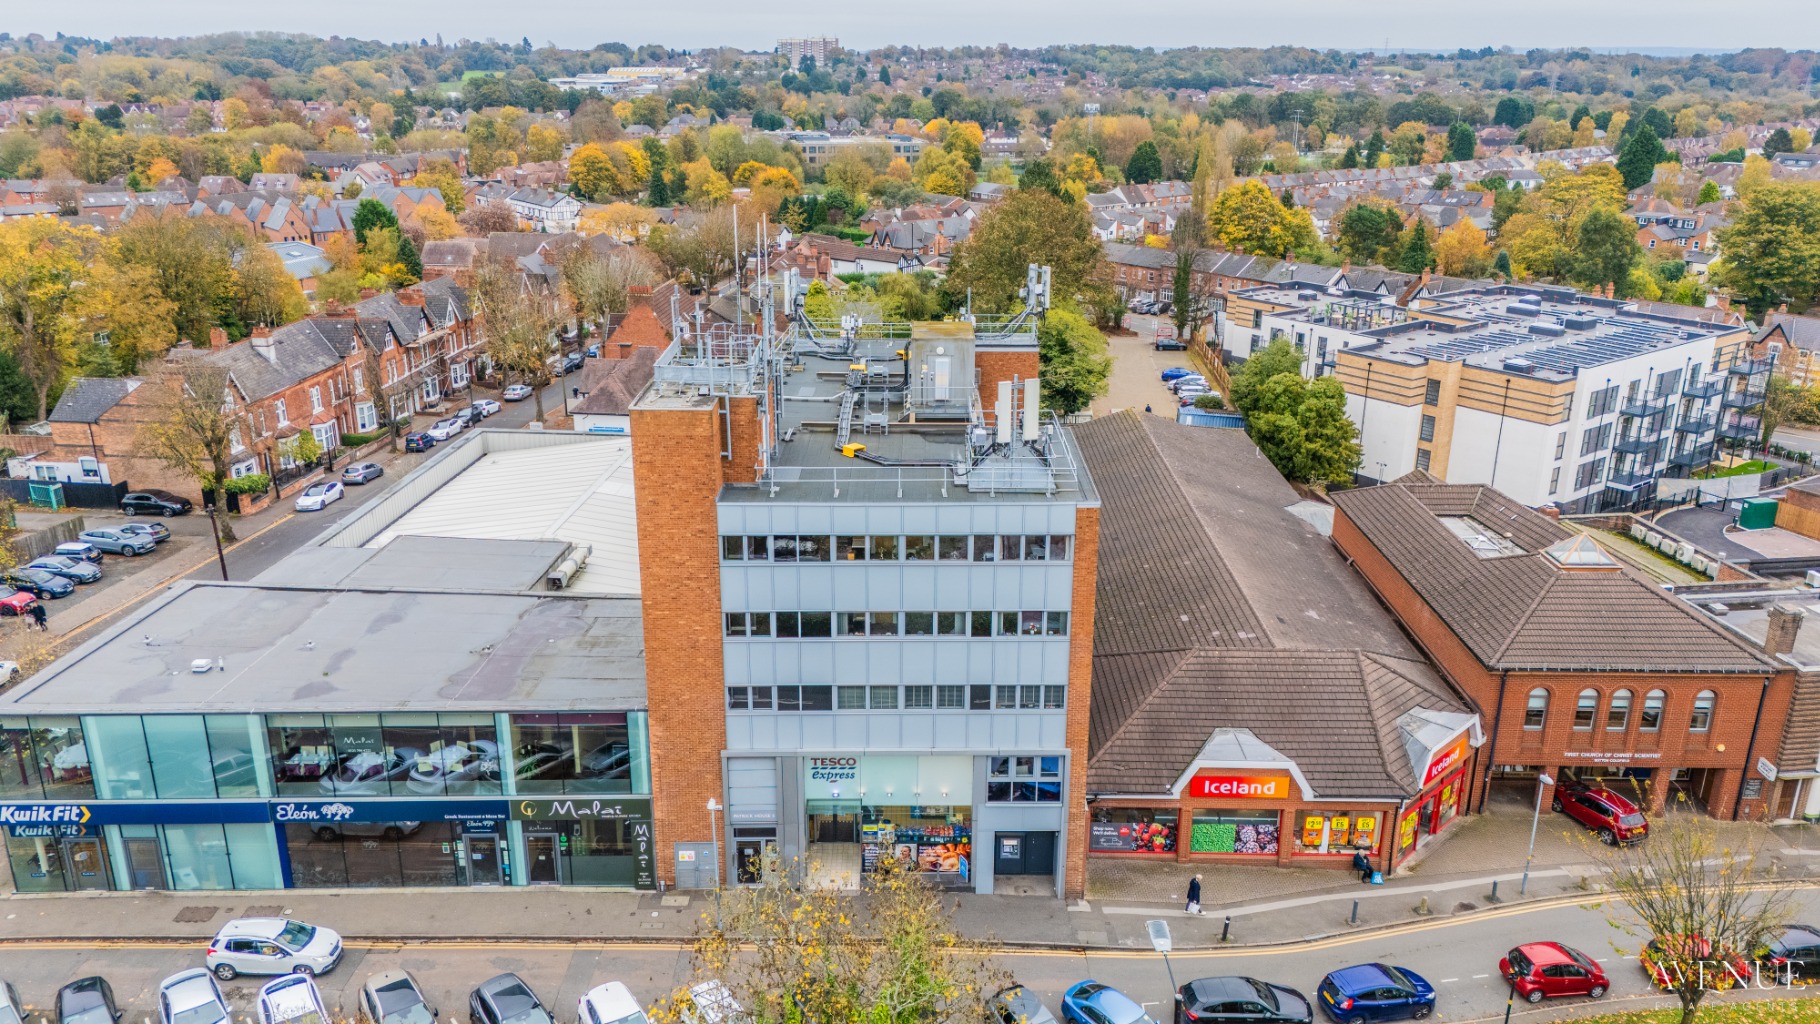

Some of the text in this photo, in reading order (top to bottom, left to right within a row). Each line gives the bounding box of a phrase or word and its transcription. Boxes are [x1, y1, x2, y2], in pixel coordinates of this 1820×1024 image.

[811, 758, 857, 766] TESCO
[1431, 747, 1460, 778] Iceland
[1204, 780, 1276, 795] Iceland
[276, 803, 320, 820] Eleón
[15, 825, 52, 836] Kwik
